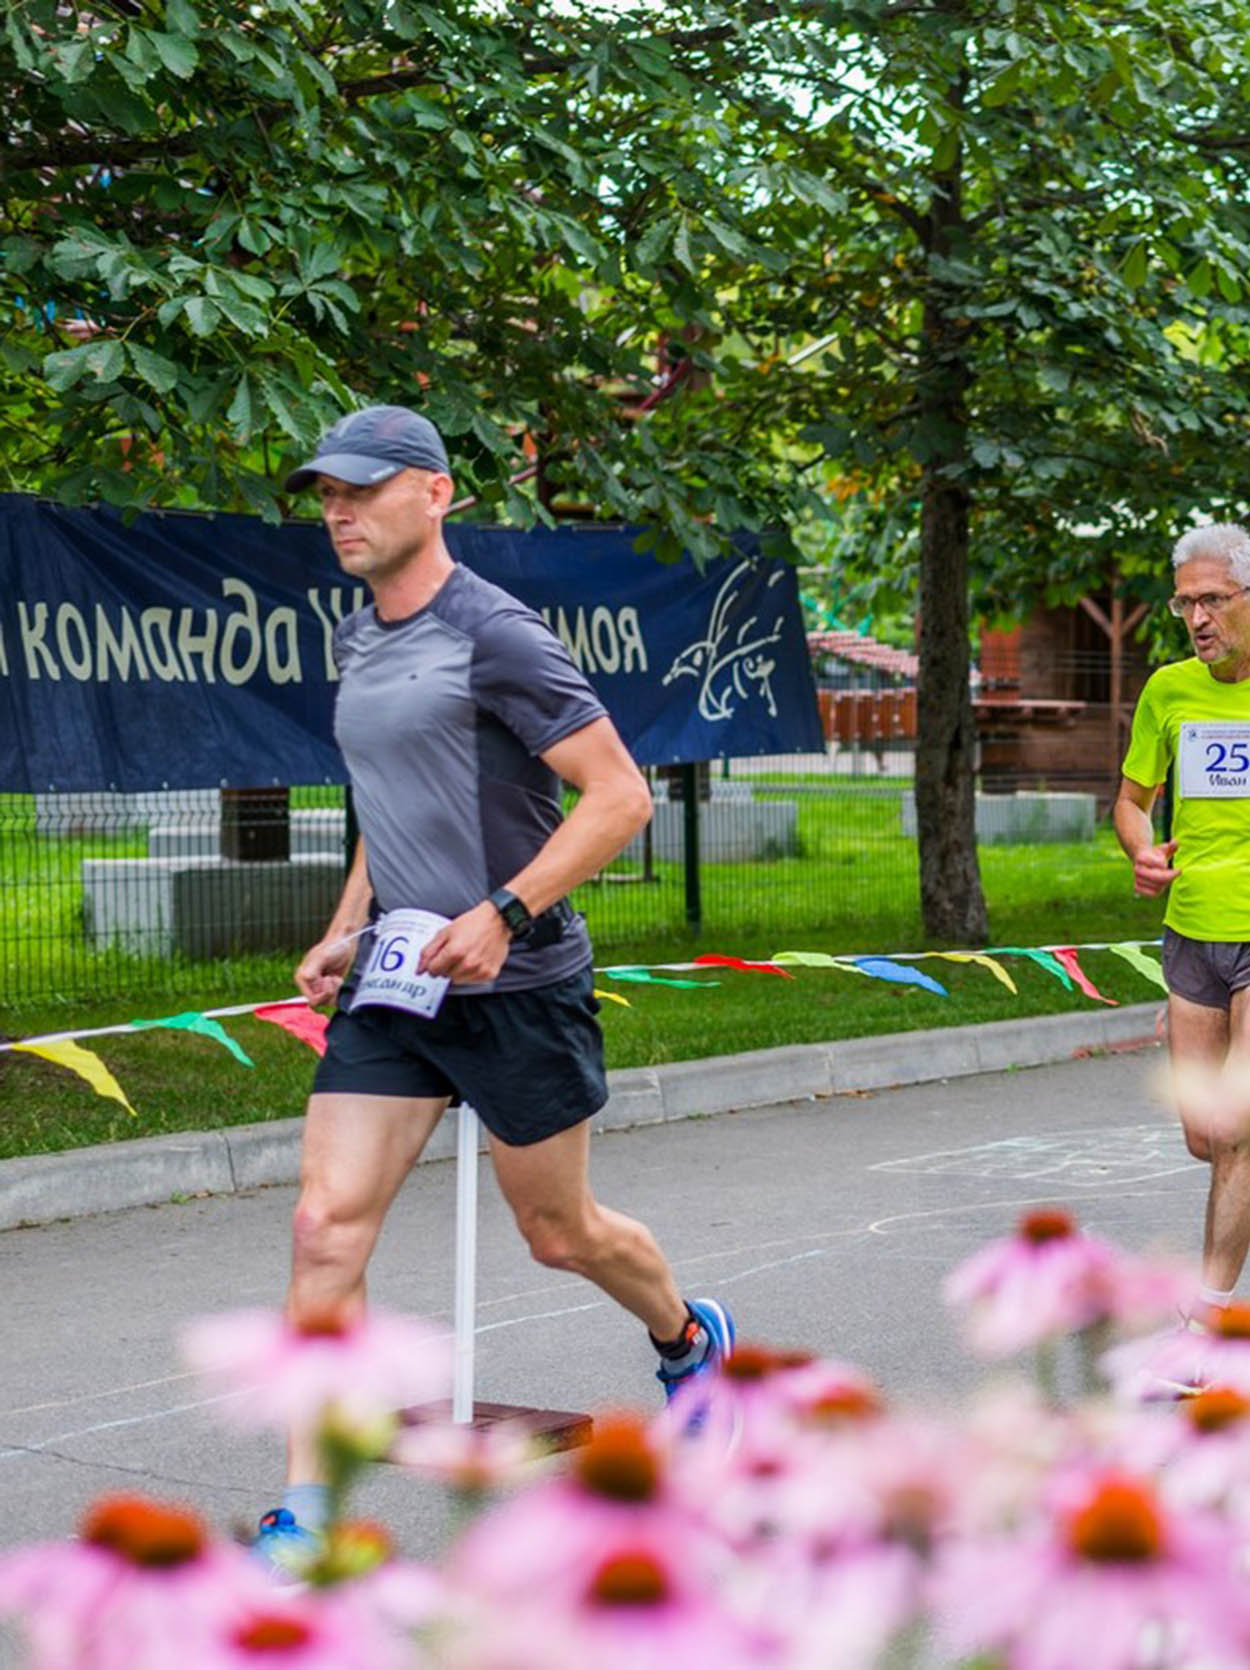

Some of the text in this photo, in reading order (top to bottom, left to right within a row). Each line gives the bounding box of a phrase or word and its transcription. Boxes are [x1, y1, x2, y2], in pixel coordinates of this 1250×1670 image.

[17, 577, 302, 685] команда
[1205, 743, 1250, 773] 25
[1208, 773, 1248, 787] Иван
[370, 936, 409, 973] 16
